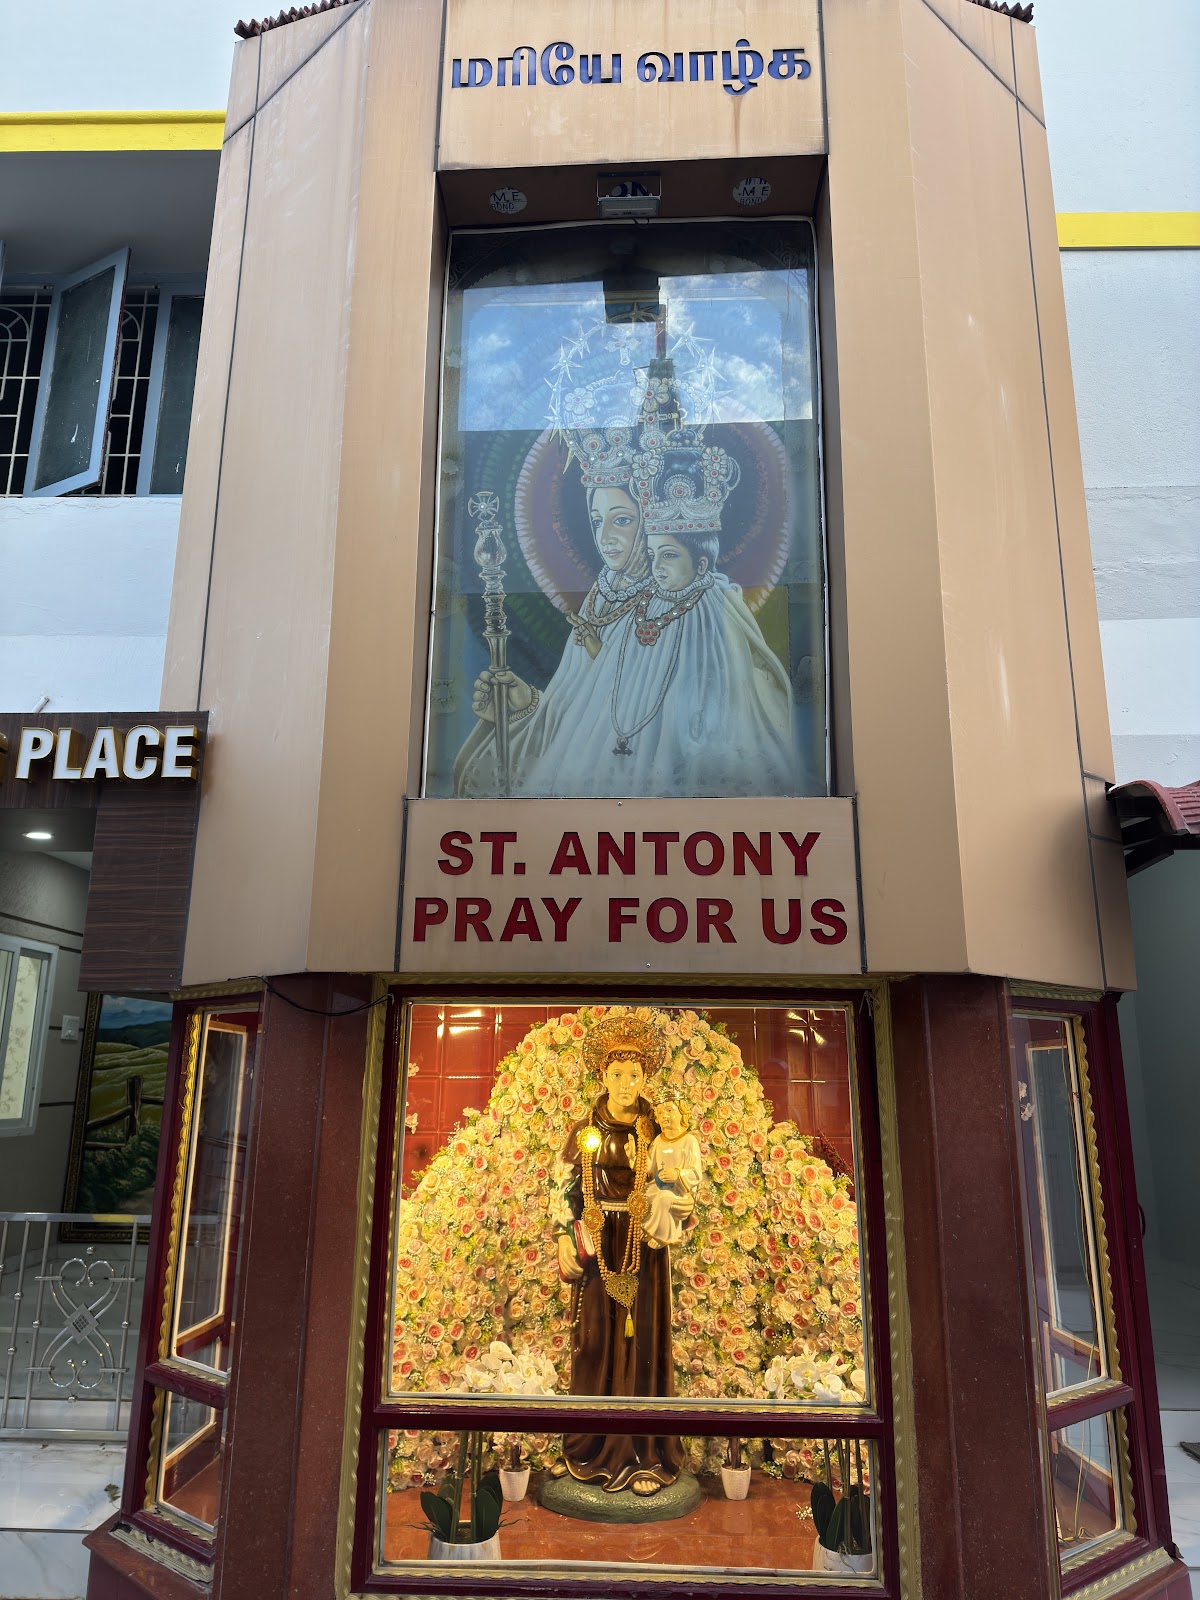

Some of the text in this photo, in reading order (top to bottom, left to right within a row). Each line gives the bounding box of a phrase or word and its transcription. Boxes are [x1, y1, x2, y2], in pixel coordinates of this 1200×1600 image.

[451, 38, 812, 96] மரியே வாழ்க
[15, 725, 196, 780] PLACE
[437, 831, 822, 877] ST. ANTONY
[412, 897, 849, 945] PRAY FOR US
